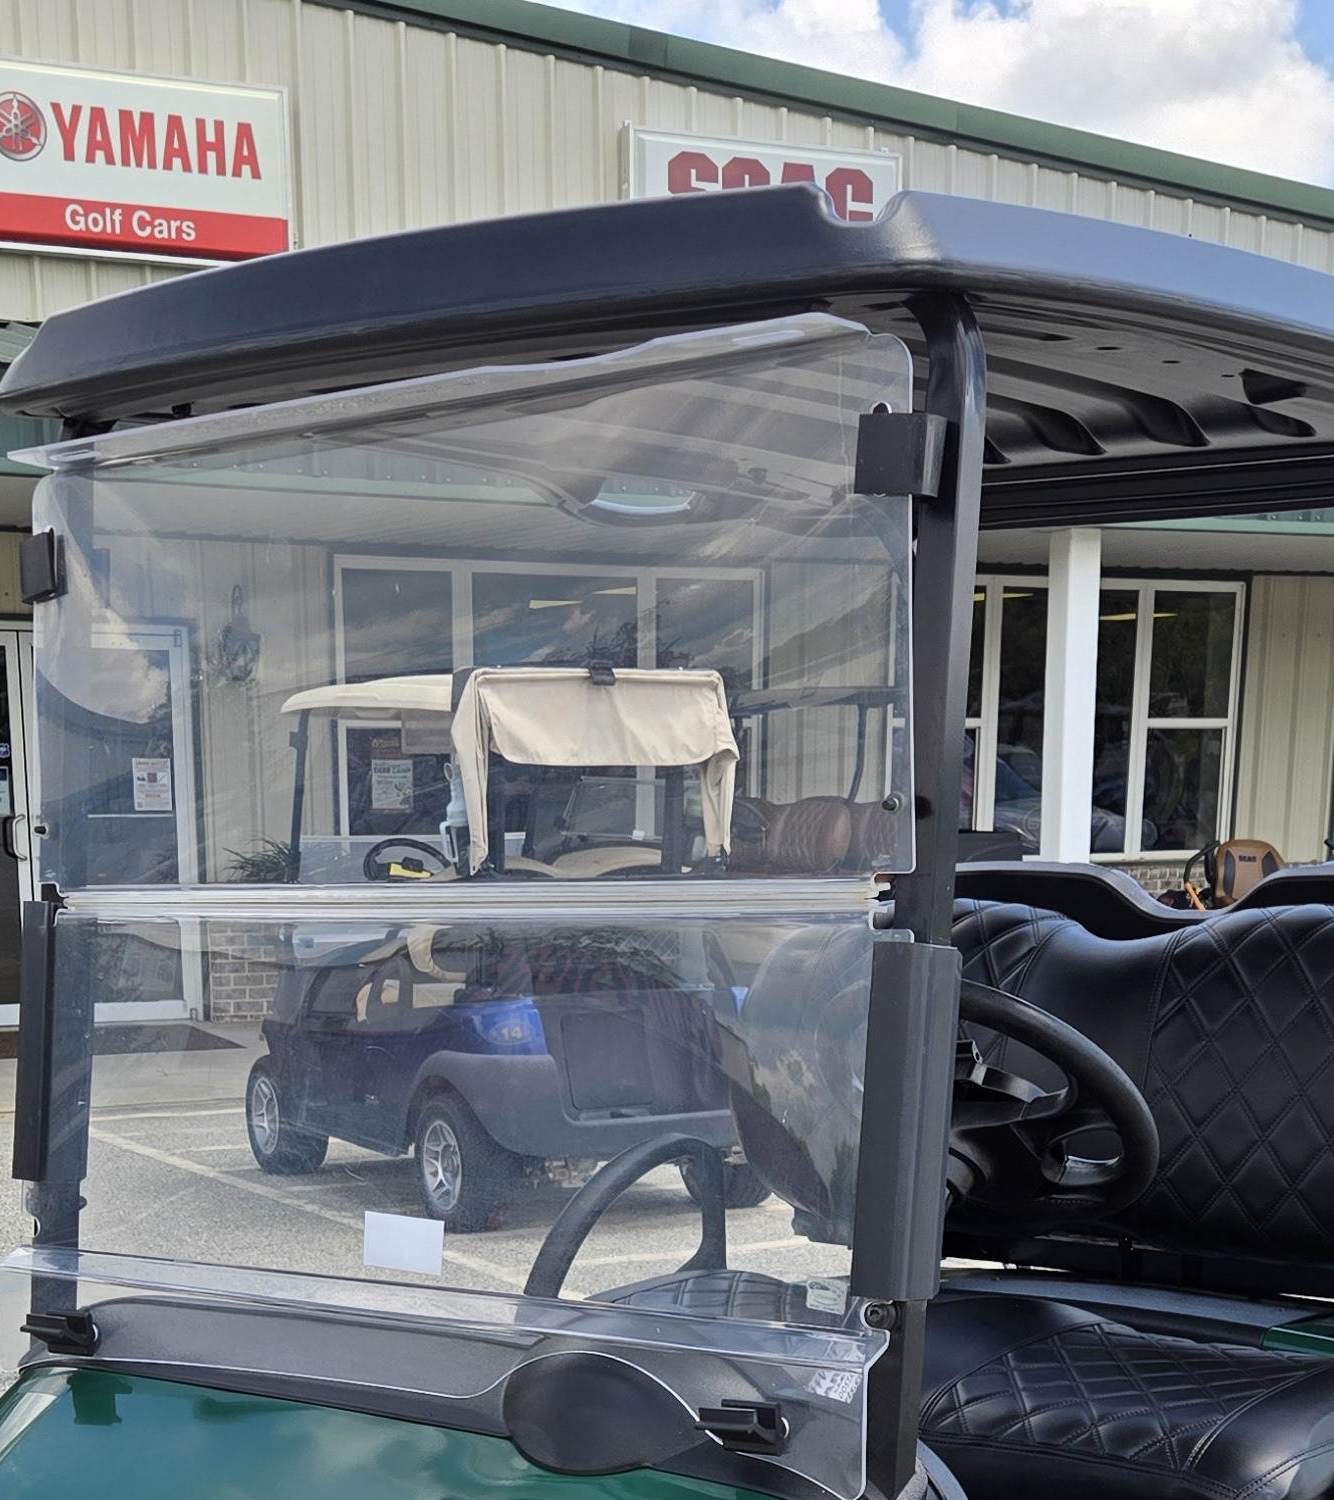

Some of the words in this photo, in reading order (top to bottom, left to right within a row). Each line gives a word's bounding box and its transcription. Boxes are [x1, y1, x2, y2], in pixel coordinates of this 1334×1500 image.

[50, 101, 262, 180] YAMAHA
[65, 203, 123, 235] Golf
[131, 209, 197, 241] Cars
[501, 1026, 523, 1039] 14
